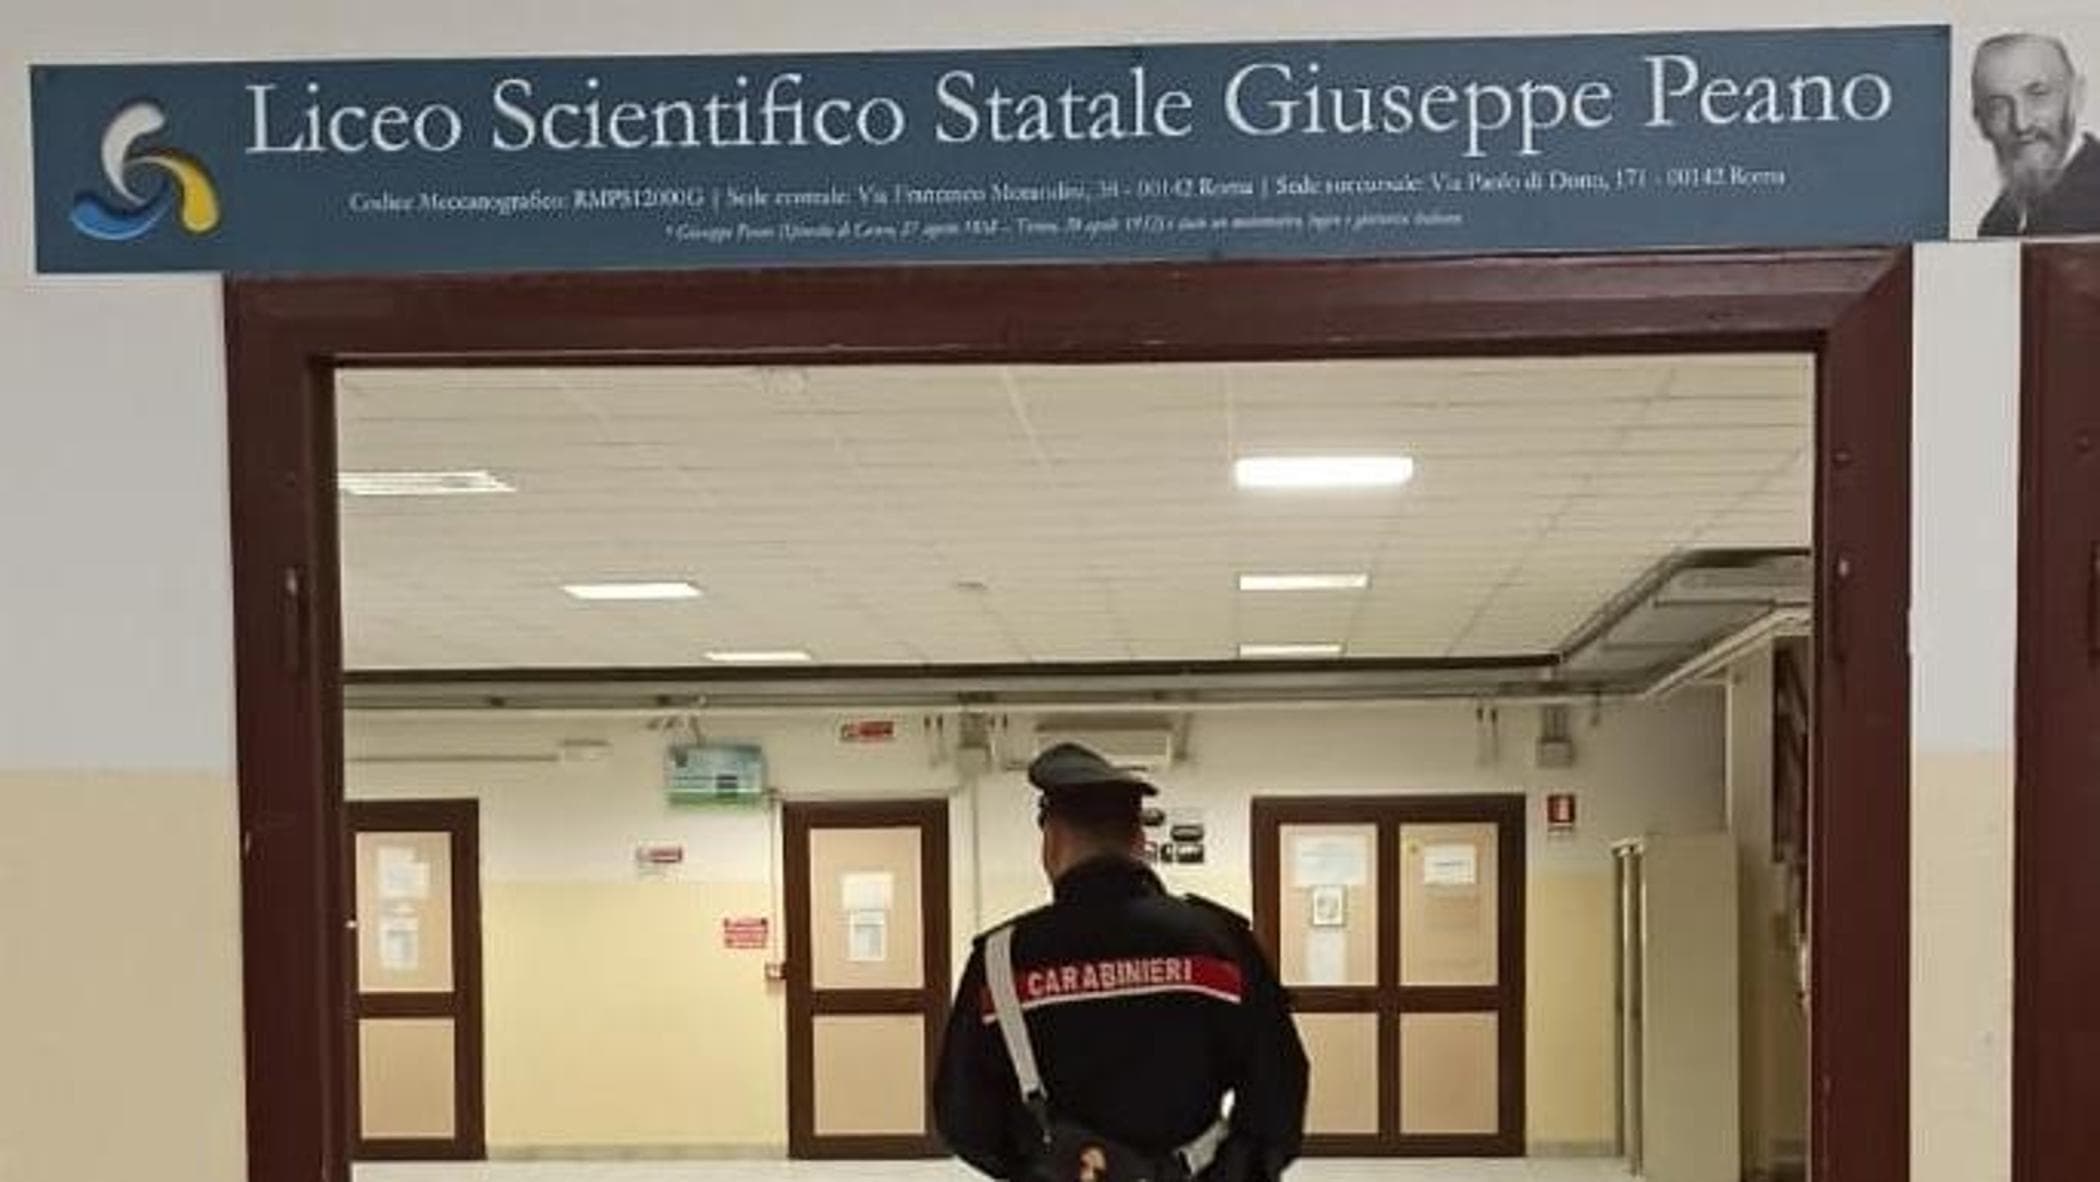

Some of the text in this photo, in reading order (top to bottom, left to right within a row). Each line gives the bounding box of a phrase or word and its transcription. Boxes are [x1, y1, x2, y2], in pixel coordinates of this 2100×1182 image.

[244, 54, 1892, 157] Liceo Scientifico Statale Giuseppe Peano
[1027, 956, 1193, 996] CARABINIERI
